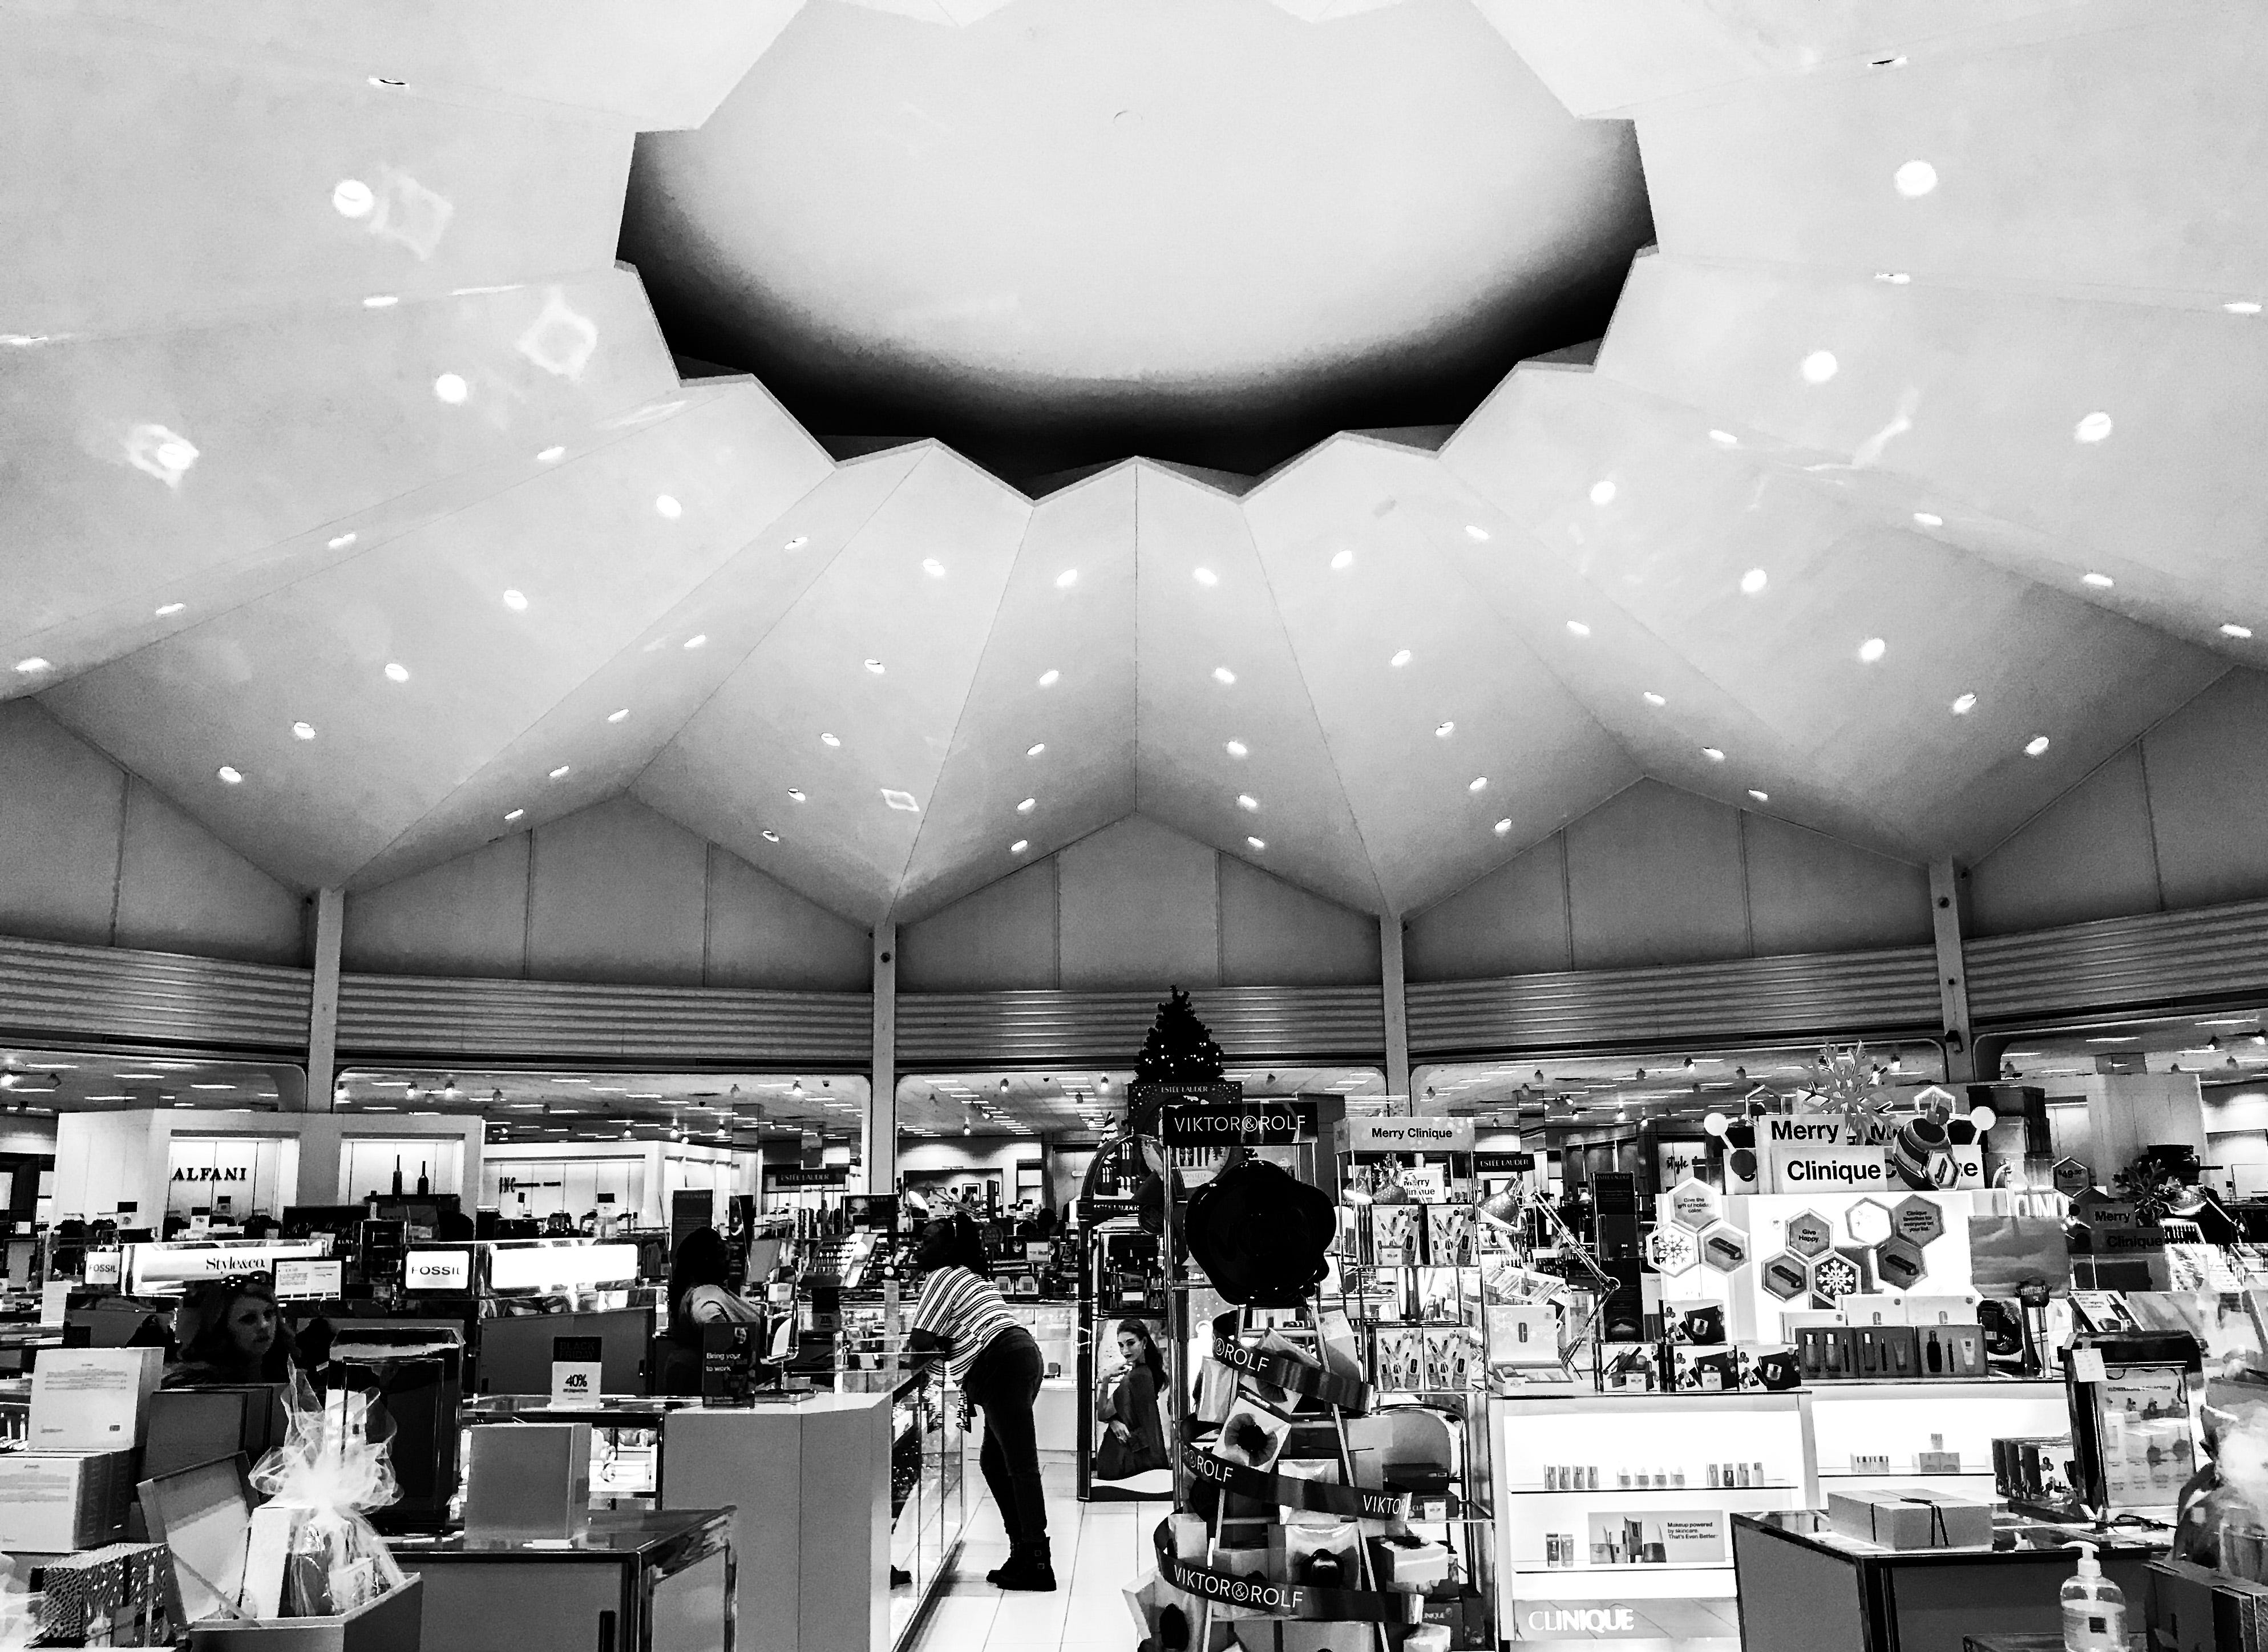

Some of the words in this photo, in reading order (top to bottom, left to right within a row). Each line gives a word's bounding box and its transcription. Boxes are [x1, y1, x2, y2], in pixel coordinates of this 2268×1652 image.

[1174, 1115, 1305, 1132] VIKTOR&ROLF
[1372, 1128, 1405, 1140] Merry
[1407, 1128, 1453, 1140] Clinique
[1770, 1120, 1839, 1144] Merry
[171, 1167, 247, 1182] ALFANI
[1787, 1160, 1881, 1185] Clinique
[2095, 1211, 2131, 1223] Merry
[2107, 1235, 2164, 1249] Clinique
[89, 1263, 118, 1273] FOSSIL
[411, 1266, 460, 1275] FOSSIL
[559, 1342, 595, 1351] BLACK
[559, 1351, 595, 1359] FRIDAY
[1214, 1337, 1270, 1372] &ROLF
[565, 1374, 588, 1387] 40%
[1187, 1448, 1233, 1483] &ROLF
[1174, 1564, 1304, 1608] VIKTOR&ROLF
[1528, 1609, 1635, 1633] CLINIQUE
